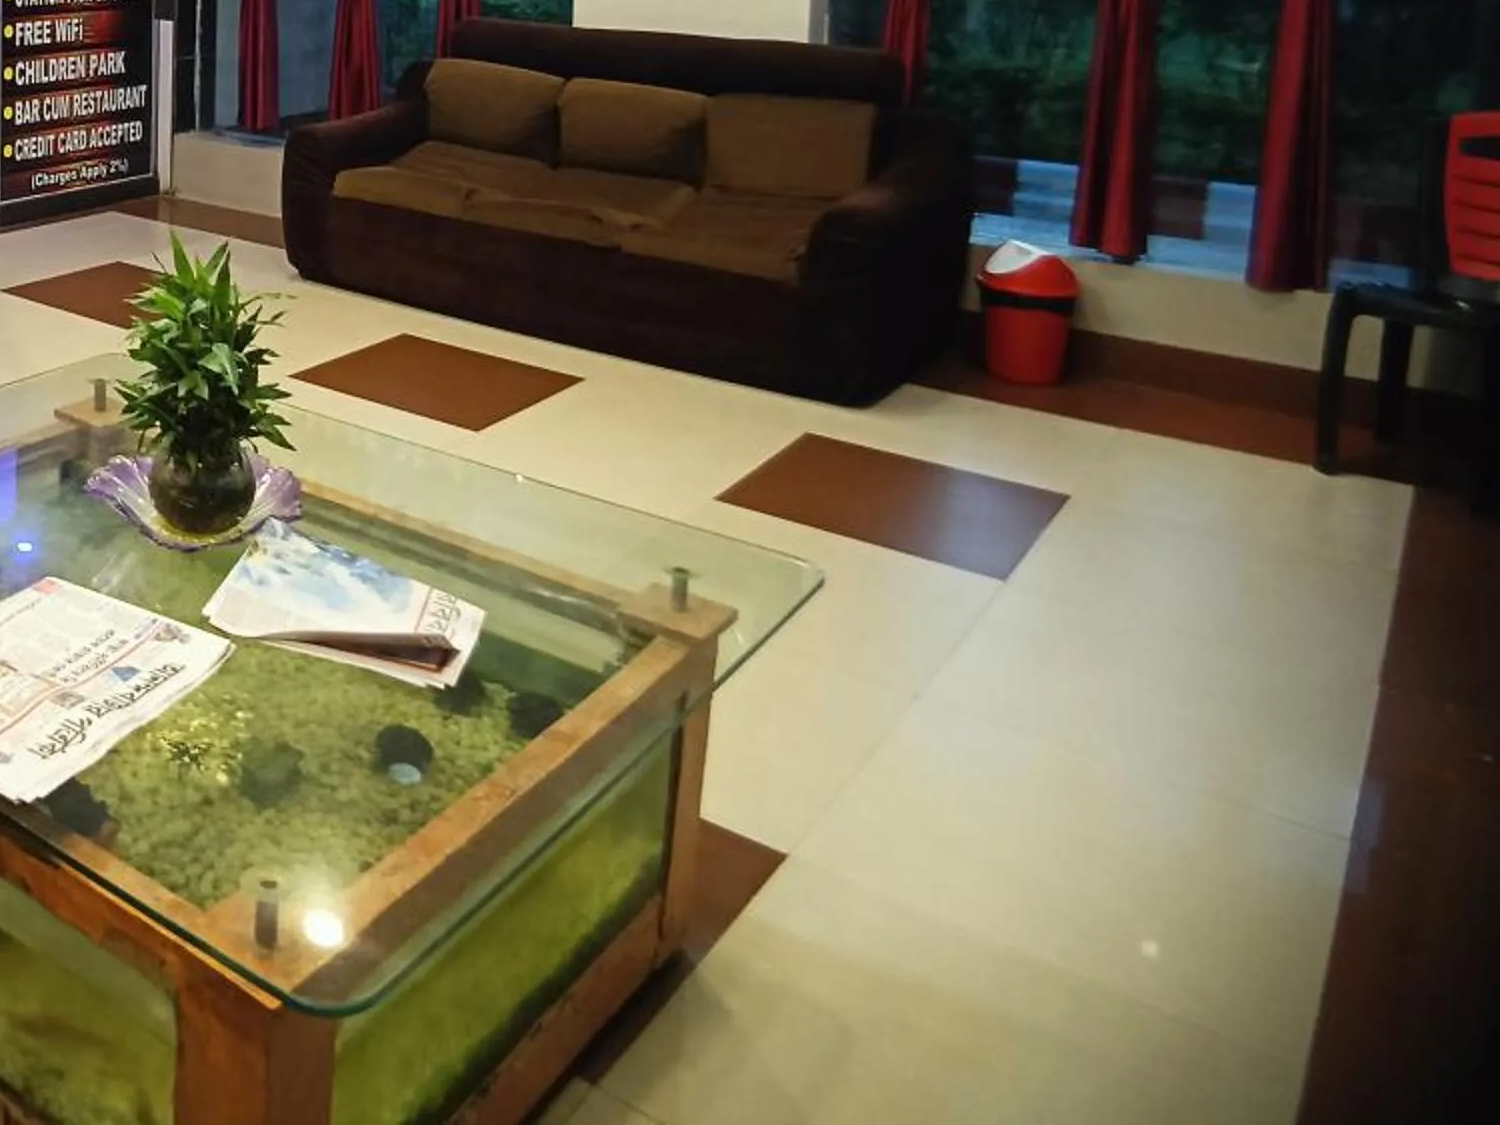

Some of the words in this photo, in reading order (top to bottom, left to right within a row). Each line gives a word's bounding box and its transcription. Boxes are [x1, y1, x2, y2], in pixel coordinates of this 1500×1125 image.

[15, 21, 51, 46] FREE
[55, 18, 84, 42] WiFi
[15, 57, 85, 86] CHILDREN
[89, 51, 126, 76] PARK
[15, 101, 40, 125] BAR
[43, 96, 70, 121] CUM
[73, 85, 148, 116] RESTAURANT
[15, 135, 55, 162] CREDIT
[58, 129, 87, 154] CARD
[89, 121, 143, 148] ACCEPTED
[31, 169, 77, 190] (Charges
[80, 163, 107, 181] Apply
